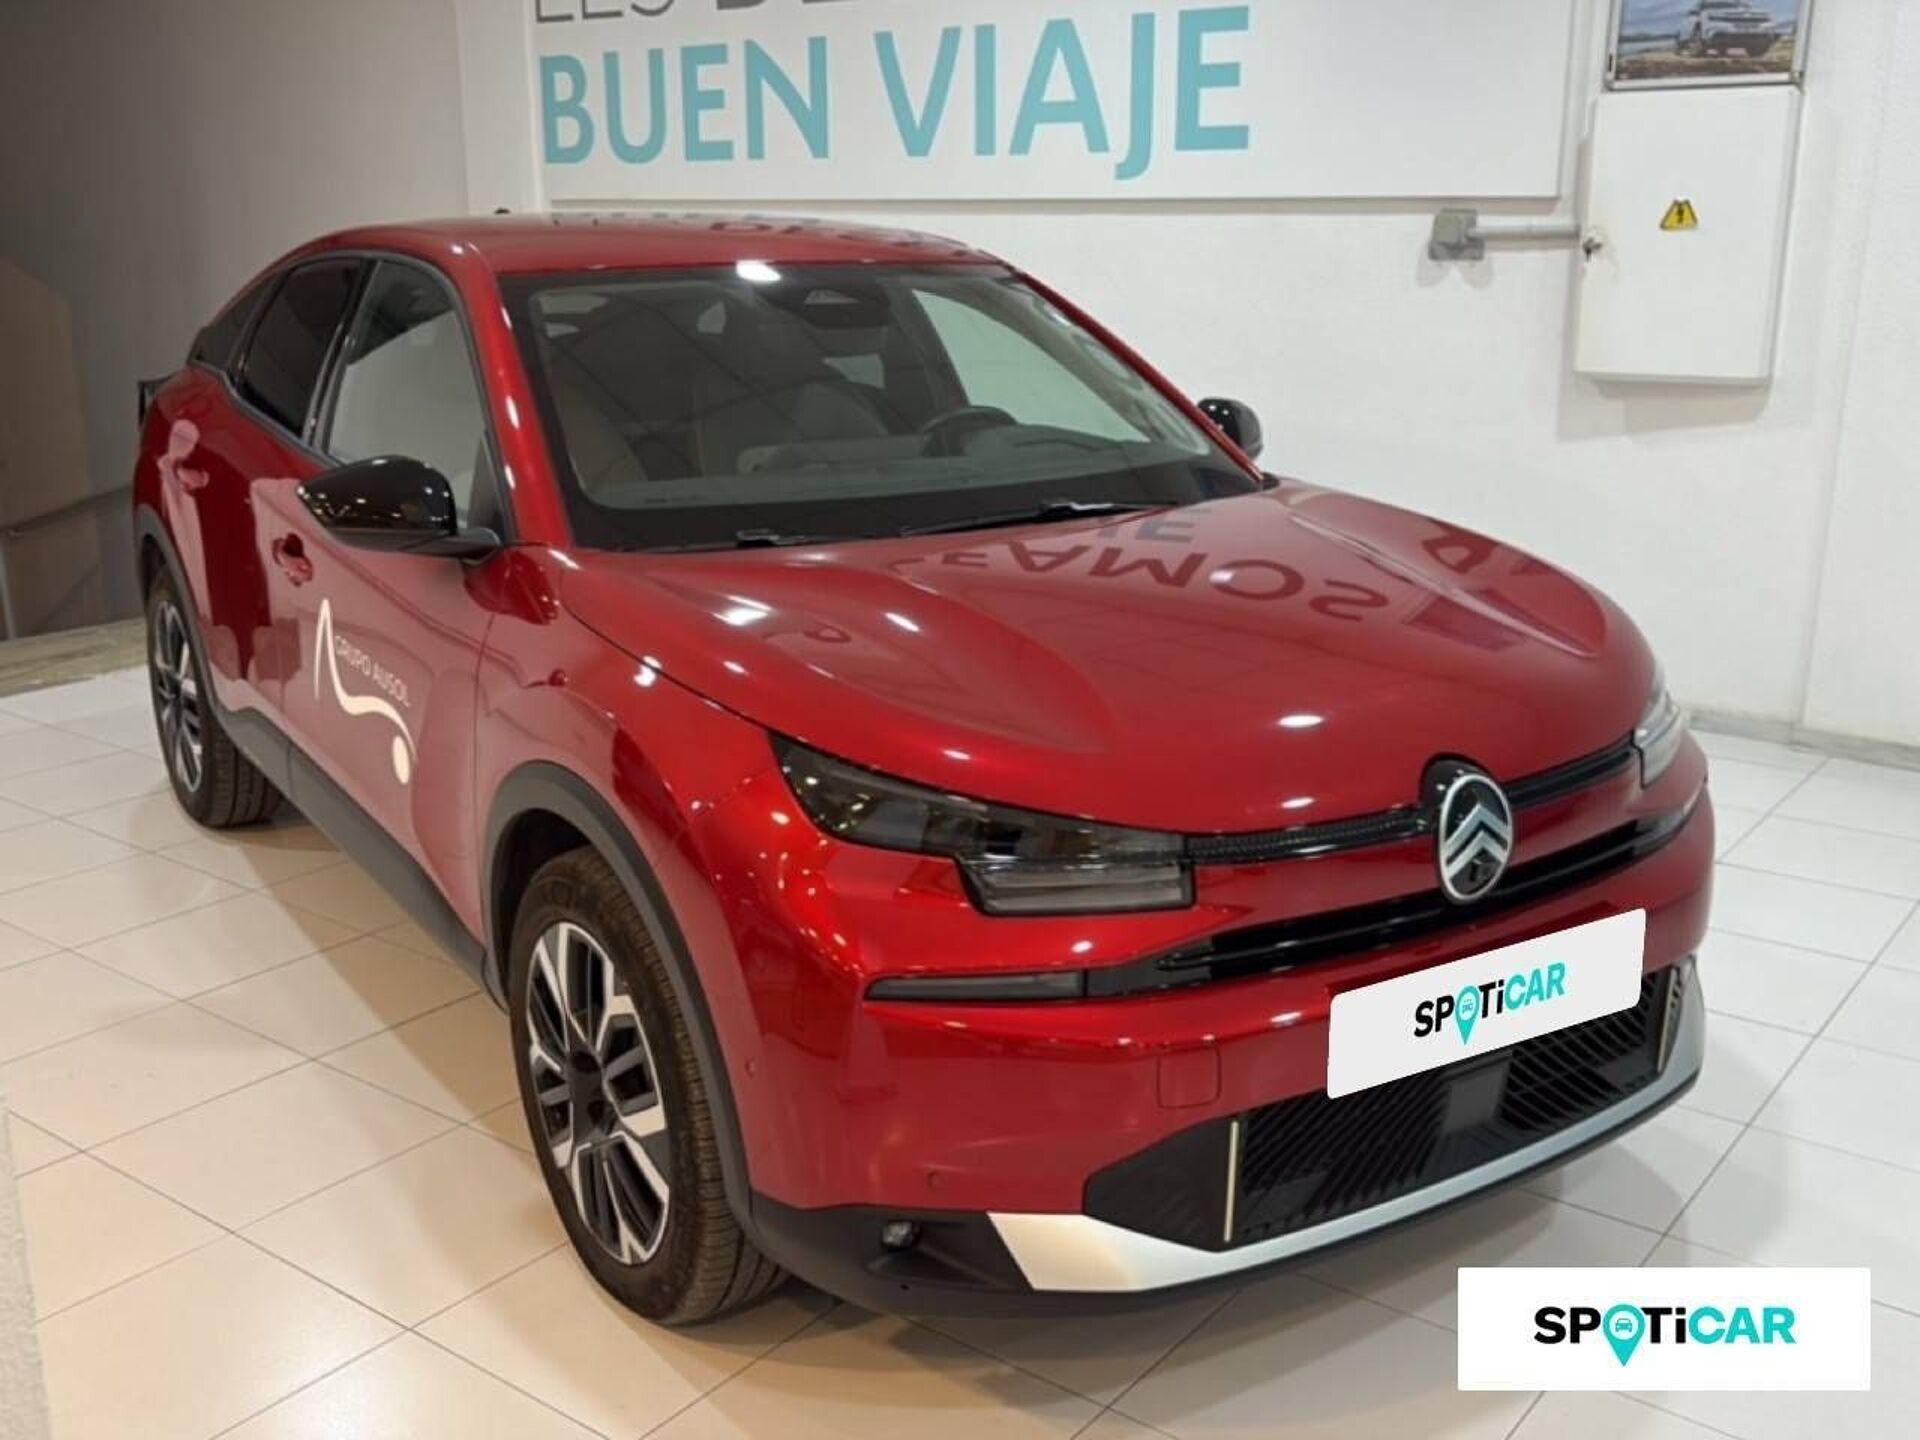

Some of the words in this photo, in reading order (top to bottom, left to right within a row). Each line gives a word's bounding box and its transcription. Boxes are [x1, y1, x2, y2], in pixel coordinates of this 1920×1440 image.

[540, 36, 829, 165] BUEN
[874, 5, 1249, 181] VIAJE
[334, 634, 371, 677] GRUPO
